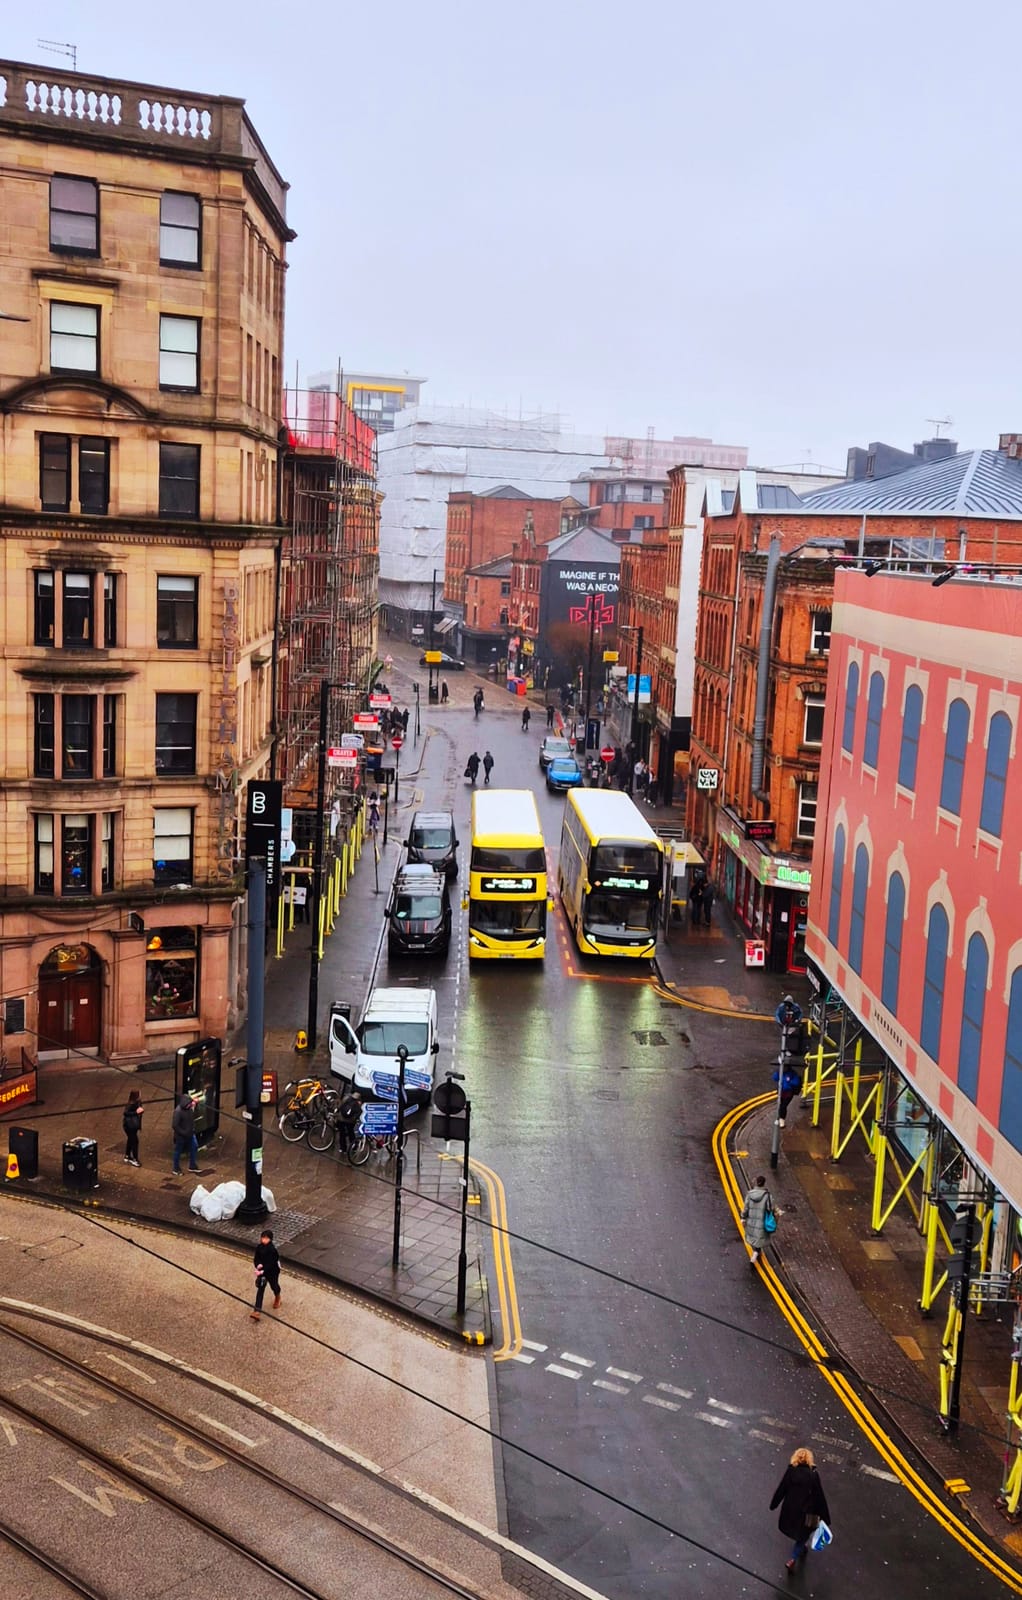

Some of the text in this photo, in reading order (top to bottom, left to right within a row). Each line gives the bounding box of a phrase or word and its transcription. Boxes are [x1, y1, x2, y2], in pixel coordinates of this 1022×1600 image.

[559, 570, 620, 581] IMAGINE IF TH
[566, 581, 586, 591] WAS
[587, 583, 594, 591] A
[266, 839, 276, 885] CHAMBERS
[778, 866, 811, 883] Alad
[49, 1408, 270, 1518] TRAM
